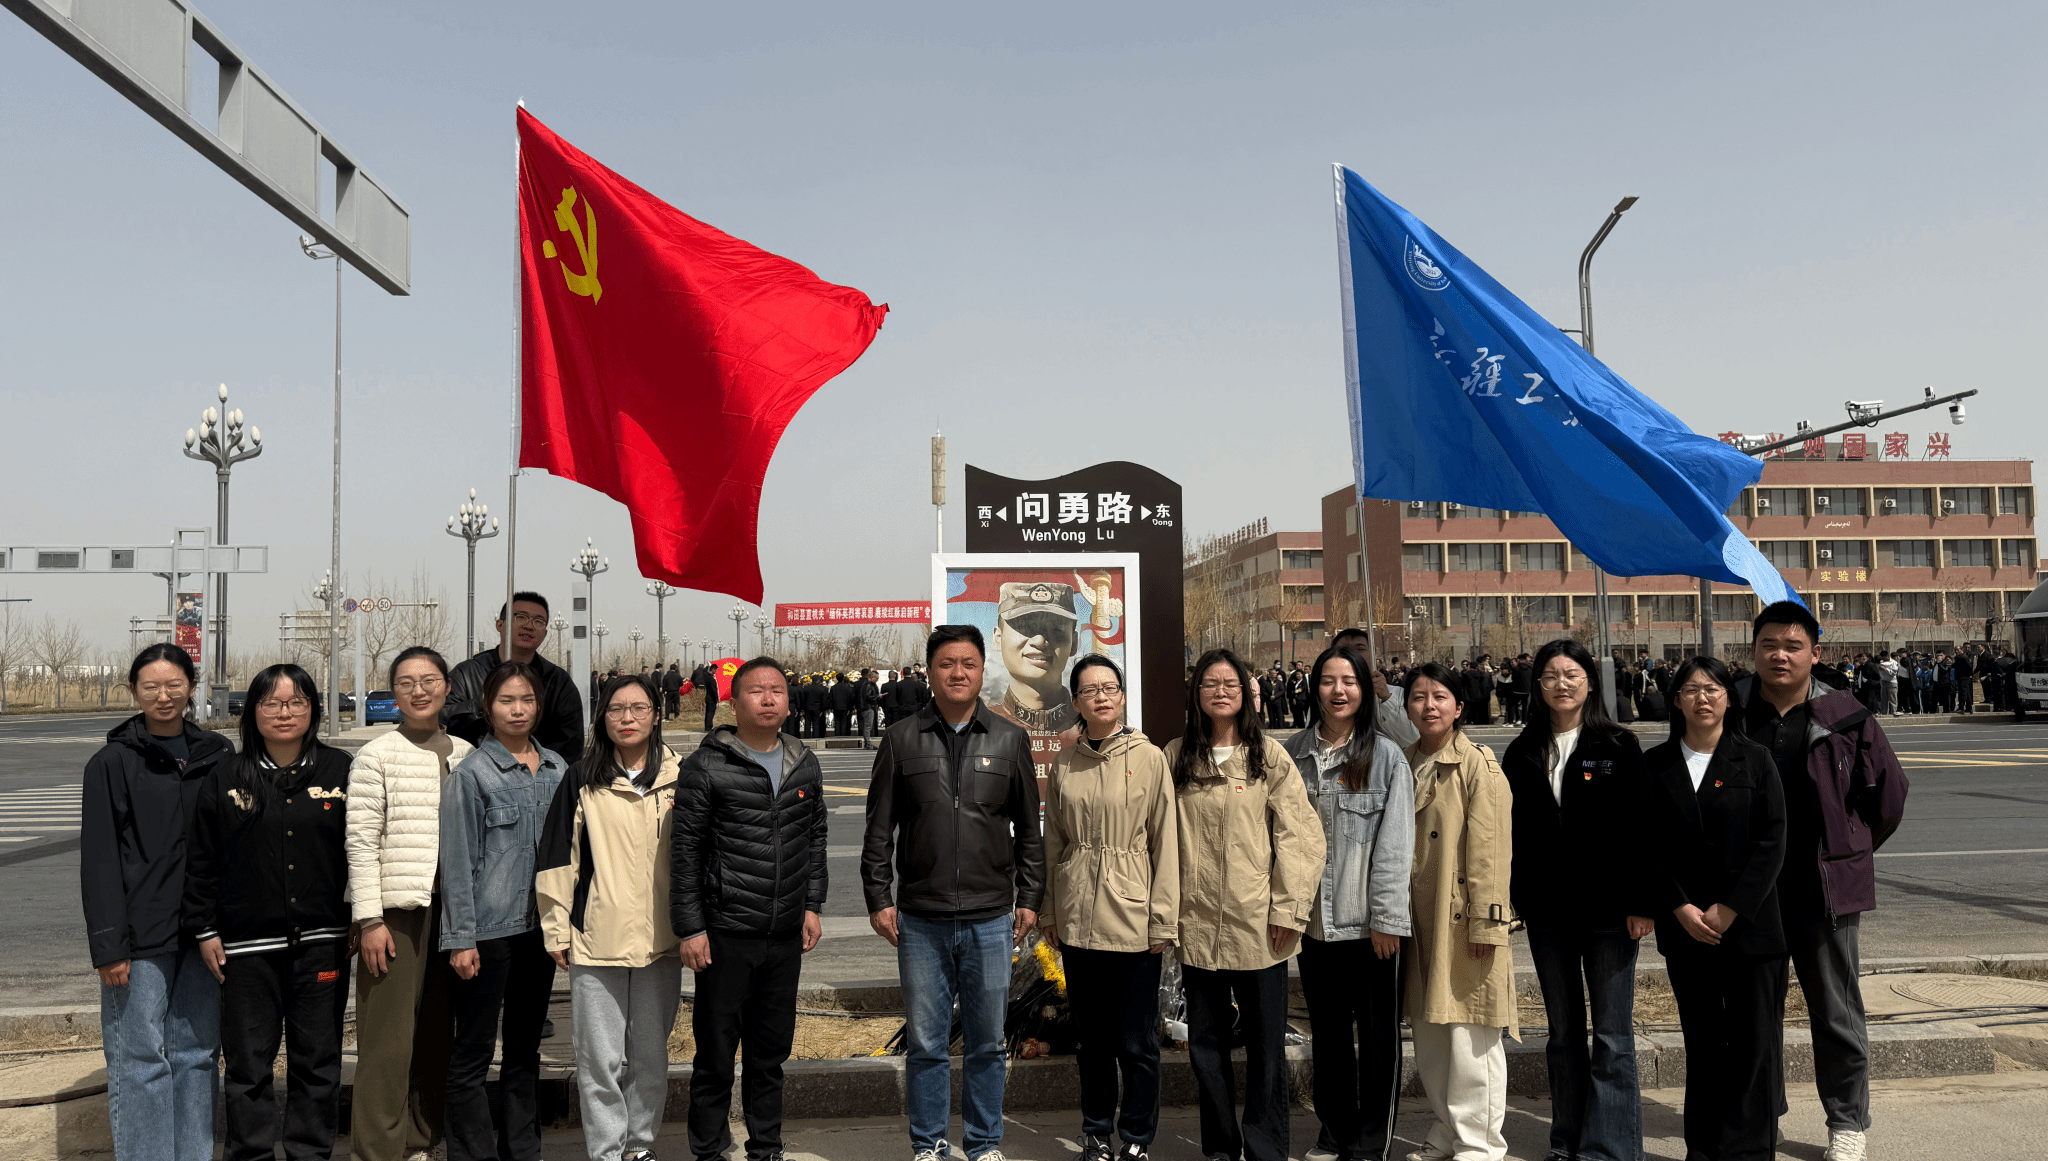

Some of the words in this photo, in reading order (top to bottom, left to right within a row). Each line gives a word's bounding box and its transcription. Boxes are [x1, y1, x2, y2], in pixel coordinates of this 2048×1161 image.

[977, 505, 993, 520] 西
[1016, 491, 1134, 525] 问勇路
[1155, 503, 1171, 519] 东
[1152, 518, 1173, 528] Dong
[1022, 528, 1086, 544] WenYong
[1096, 527, 1115, 541] Lu
[1820, 569, 1867, 583] 实验楼
[380, 600, 389, 609] 50
[1031, 739, 1062, 752] 思远
